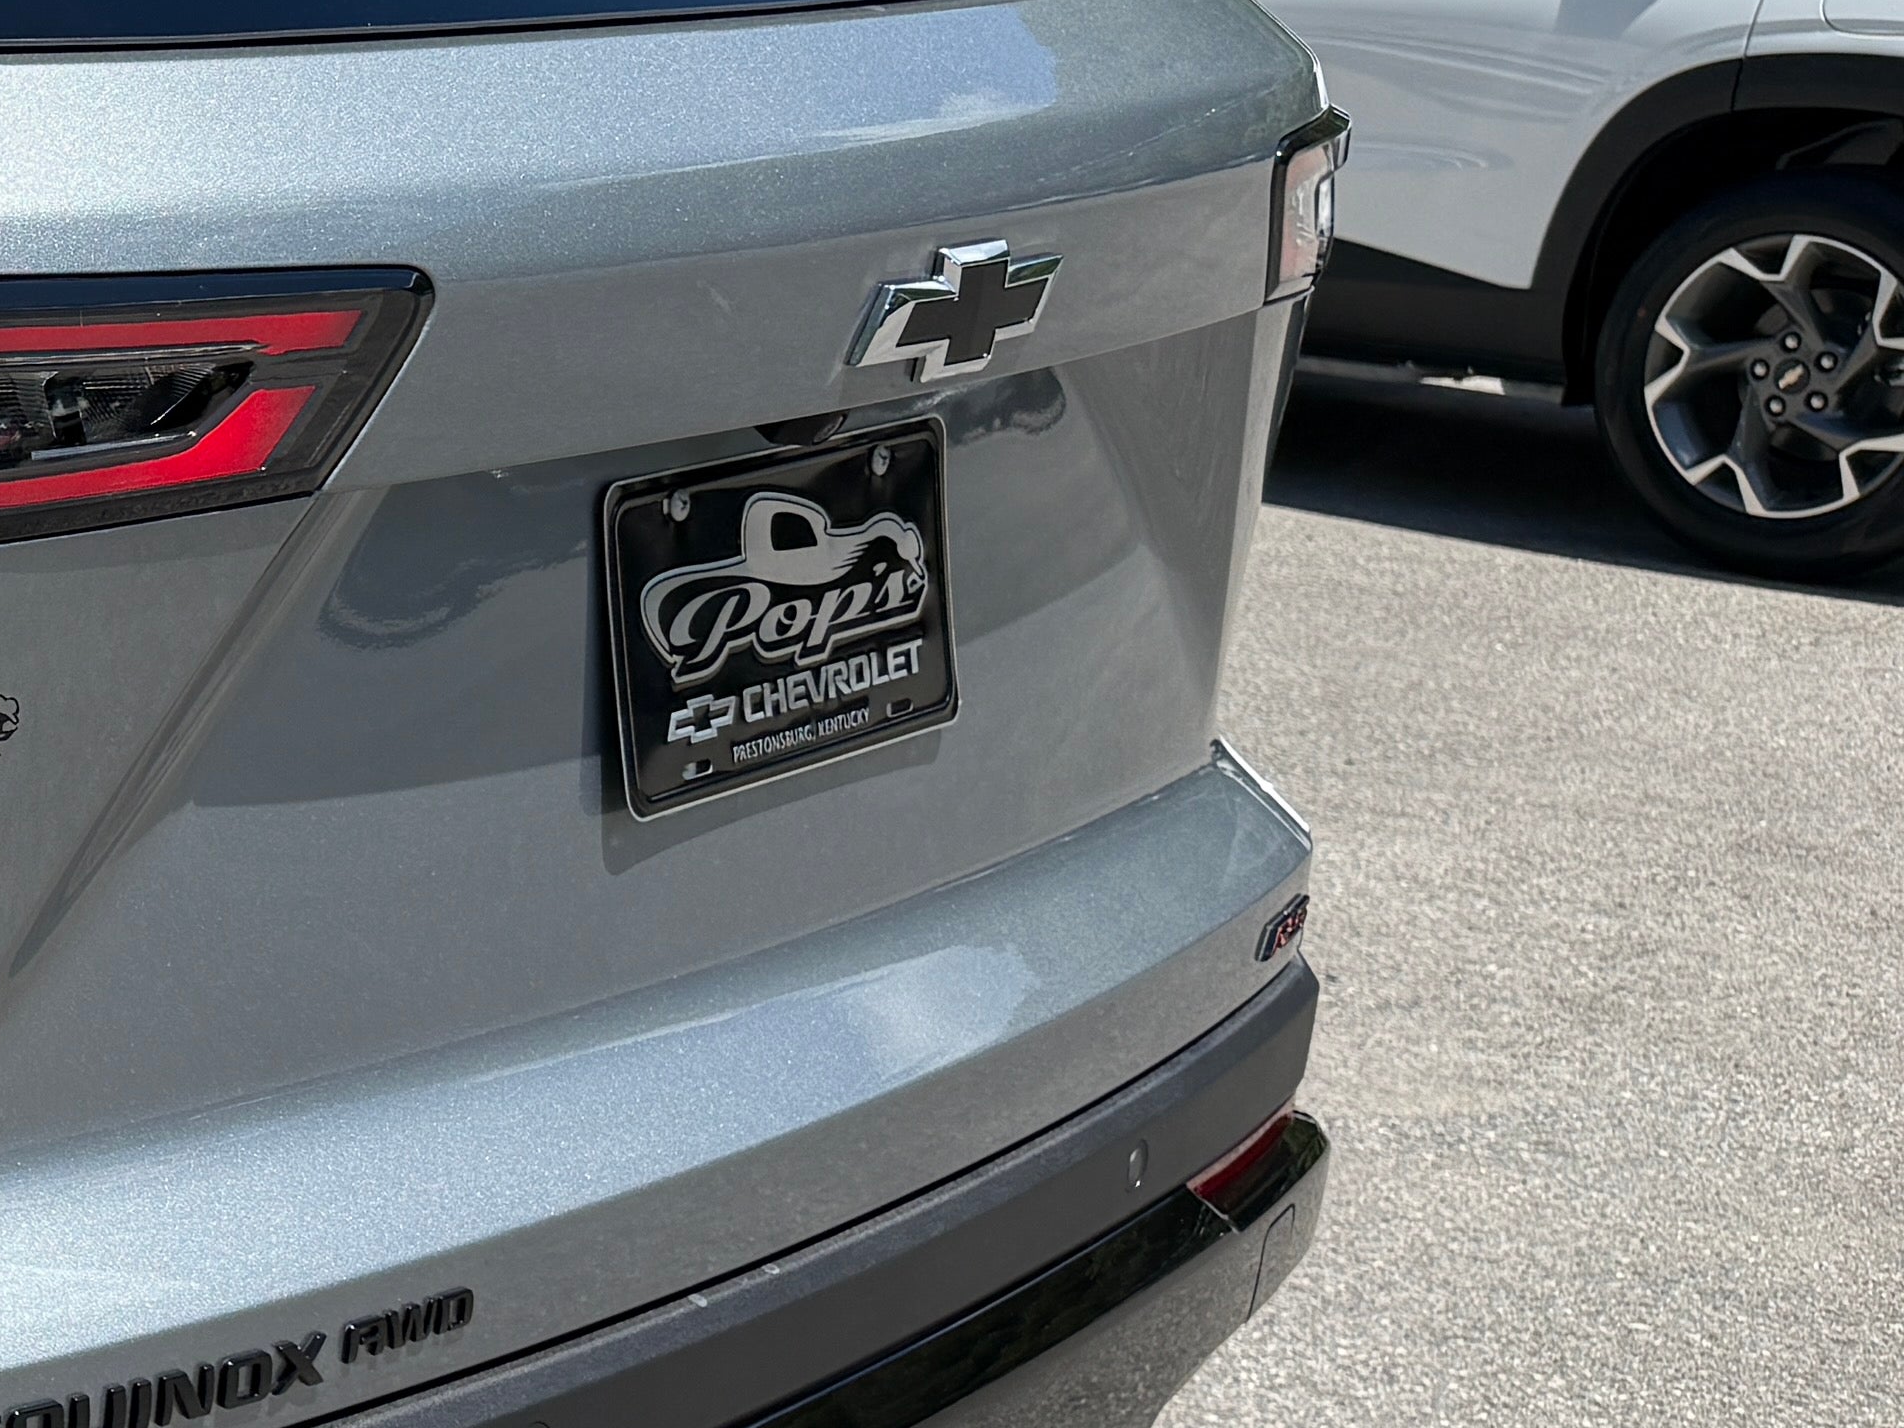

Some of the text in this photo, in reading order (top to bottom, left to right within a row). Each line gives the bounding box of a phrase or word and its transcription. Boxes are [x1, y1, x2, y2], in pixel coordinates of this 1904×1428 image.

[668, 560, 919, 665] Pop's
[743, 638, 924, 725] CHEVROLET
[817, 707, 870, 737] KENTUCKY
[340, 1286, 475, 1365] AWD
